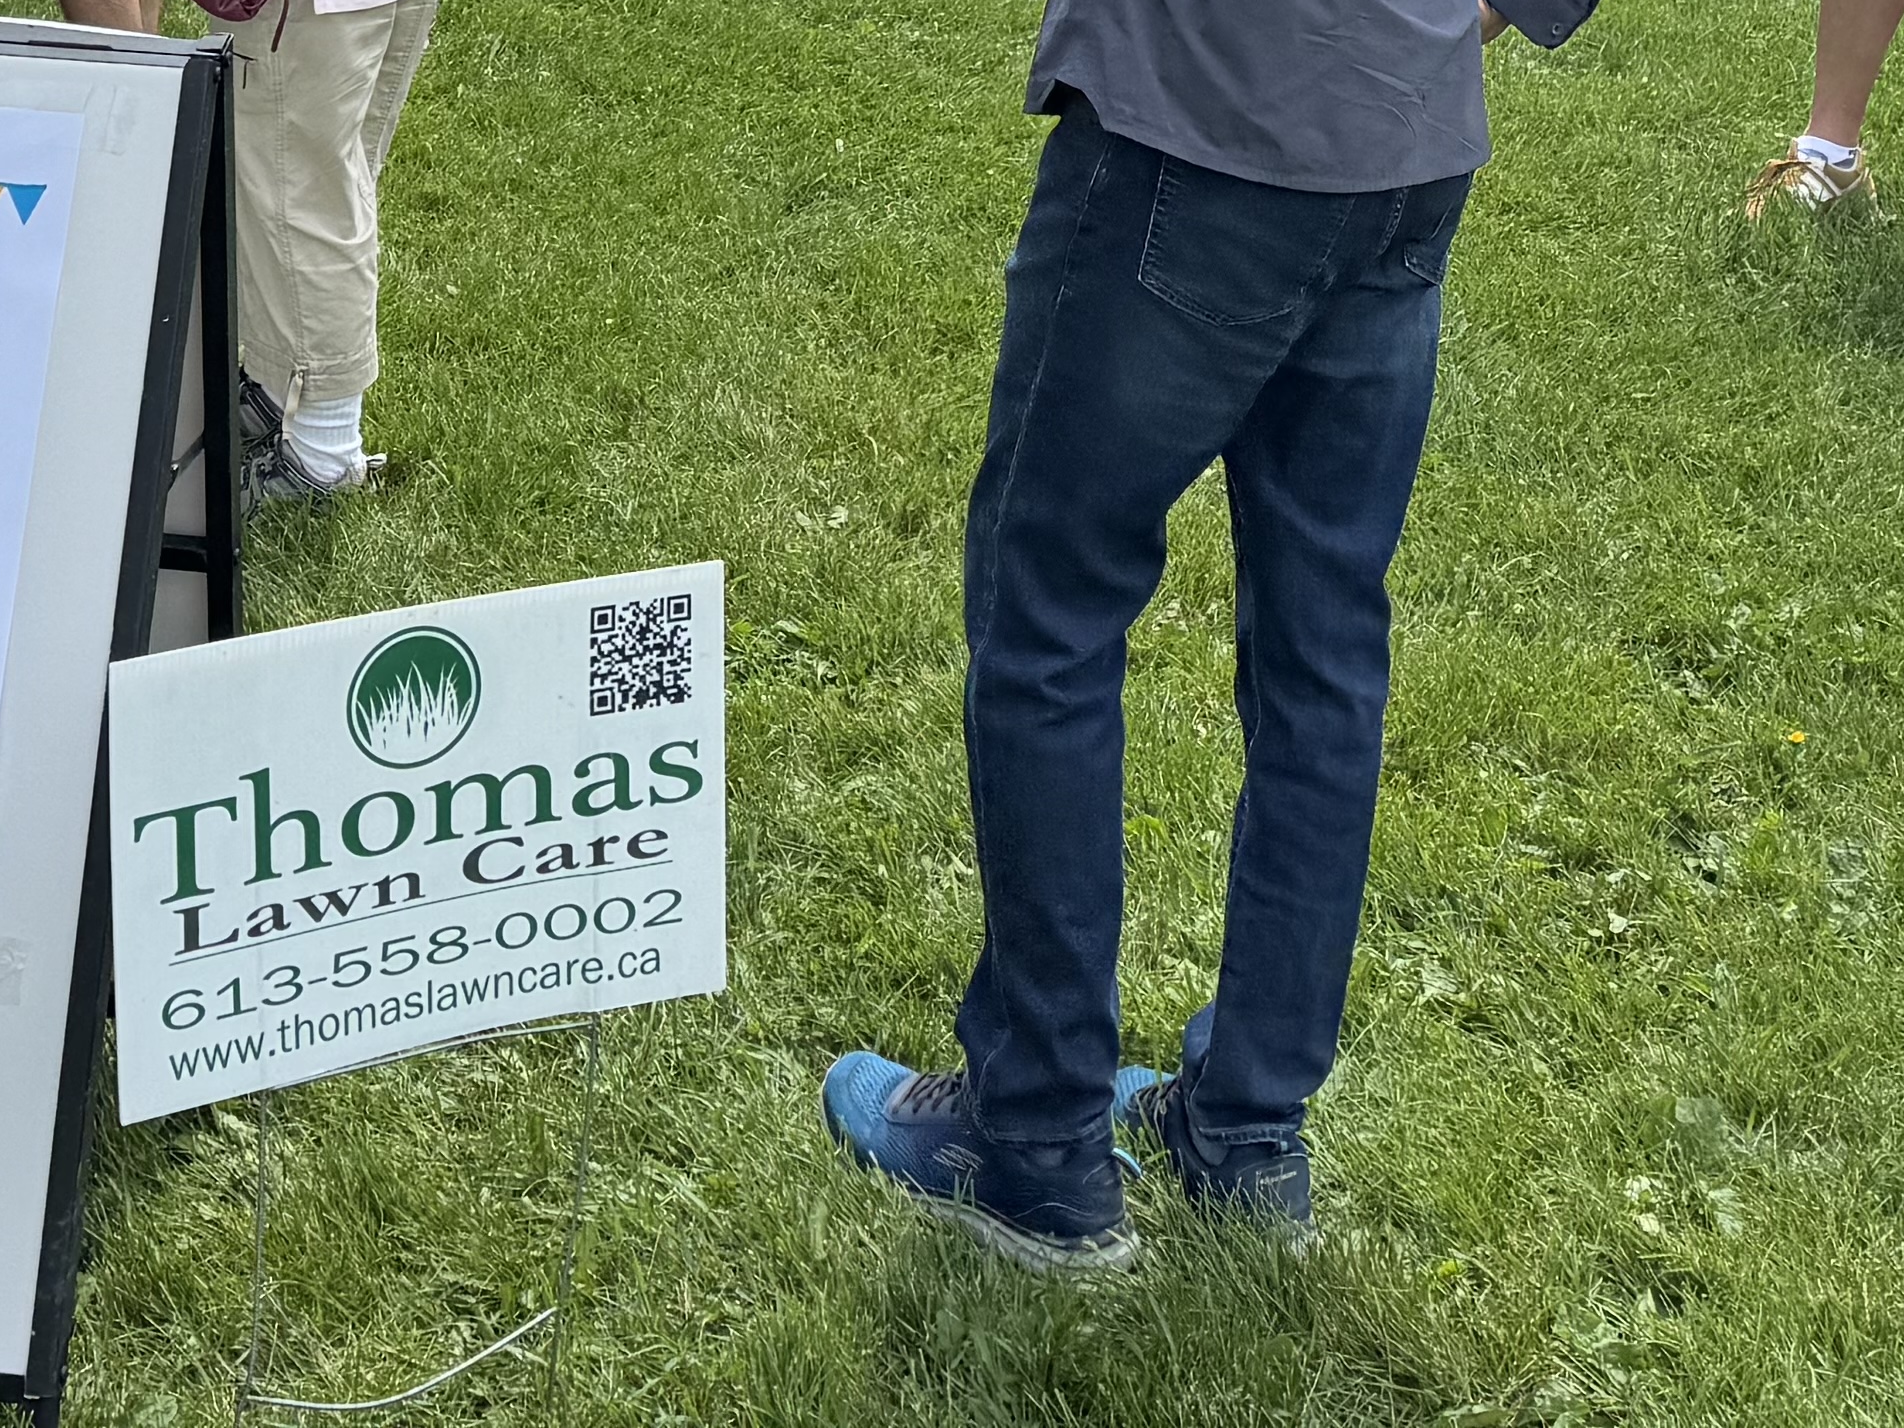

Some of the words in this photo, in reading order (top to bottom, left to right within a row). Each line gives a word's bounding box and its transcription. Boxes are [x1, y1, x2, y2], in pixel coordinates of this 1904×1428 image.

[131, 737, 704, 906] Thomas
[159, 888, 684, 1031] 613-558-0002
[172, 868, 426, 957] Lawn
[460, 826, 670, 886] Care
[168, 947, 662, 1081] www.thomaslawncare.ca
